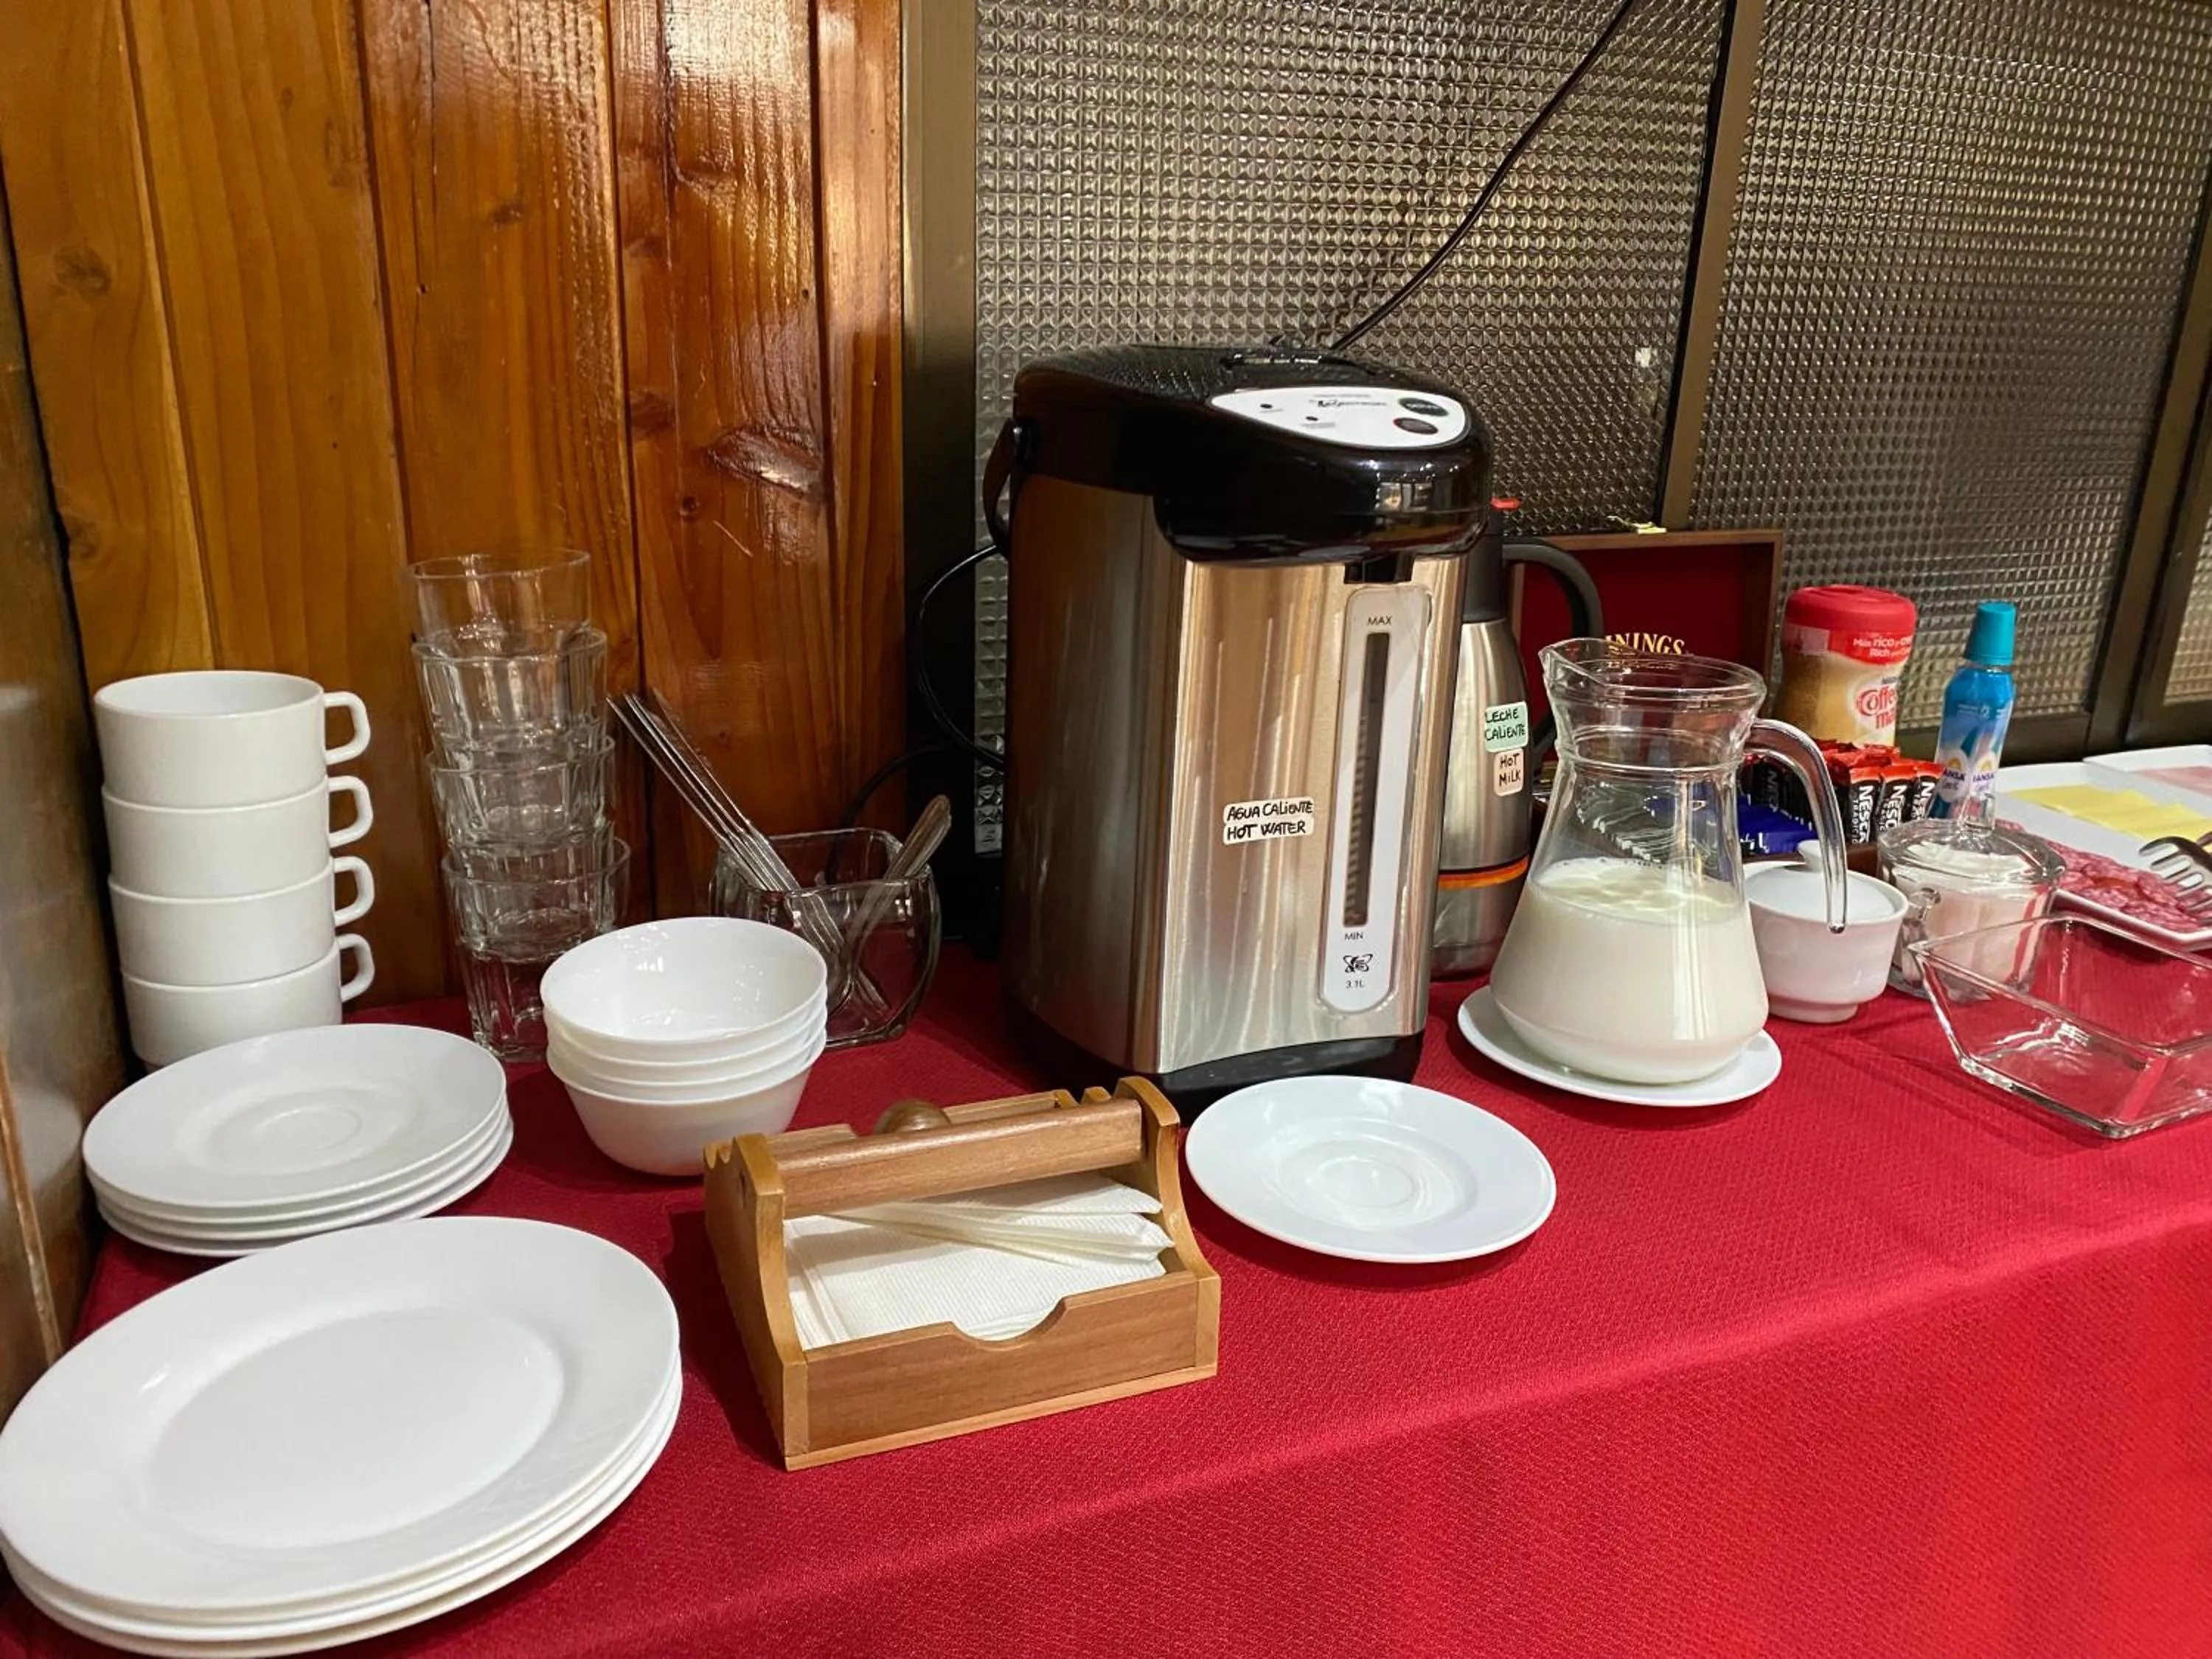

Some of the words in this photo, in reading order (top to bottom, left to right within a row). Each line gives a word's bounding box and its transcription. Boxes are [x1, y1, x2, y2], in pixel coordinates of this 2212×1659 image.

[1367, 615, 1392, 626] MAX
[1485, 708, 1519, 723] LECHE
[1227, 806, 1260, 821] AGUA
[1858, 785, 1874, 844] NESCA
[1227, 824, 1258, 841] HOT
[1261, 820, 1306, 836] WATER
[1344, 931, 1363, 940] MIN
